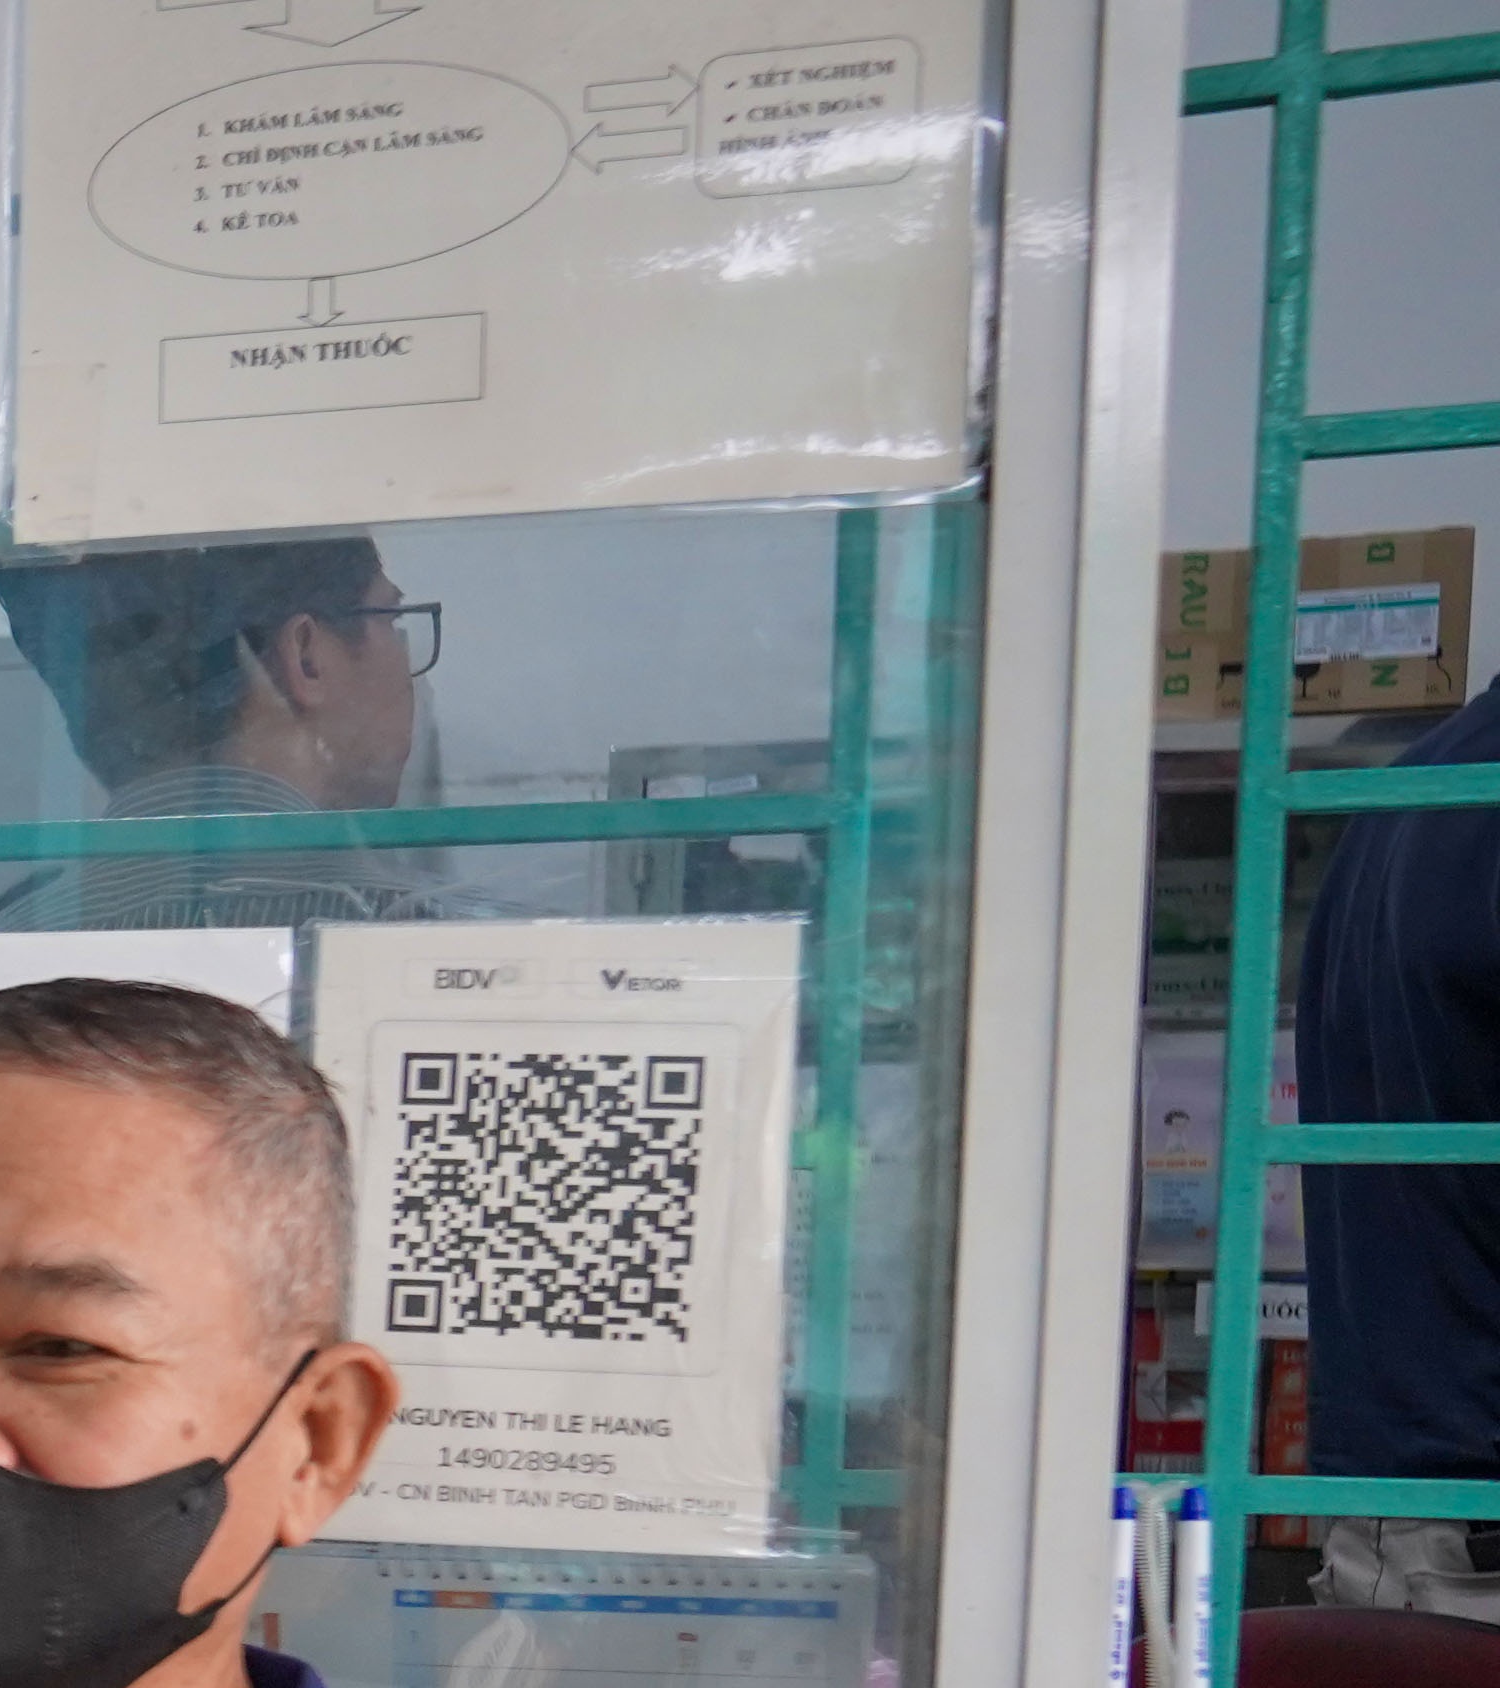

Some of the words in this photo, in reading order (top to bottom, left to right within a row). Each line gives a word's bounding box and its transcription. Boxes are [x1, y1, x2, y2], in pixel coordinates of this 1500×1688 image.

[230, 343, 306, 370] NHẬN
[313, 331, 414, 362] THUỐC
[389, 1407, 497, 1431] NGUYEN
[505, 1411, 547, 1431] THI
[554, 1413, 582, 1433] LE
[590, 1415, 672, 1437] HANG
[437, 1447, 616, 1475] 1490289495
